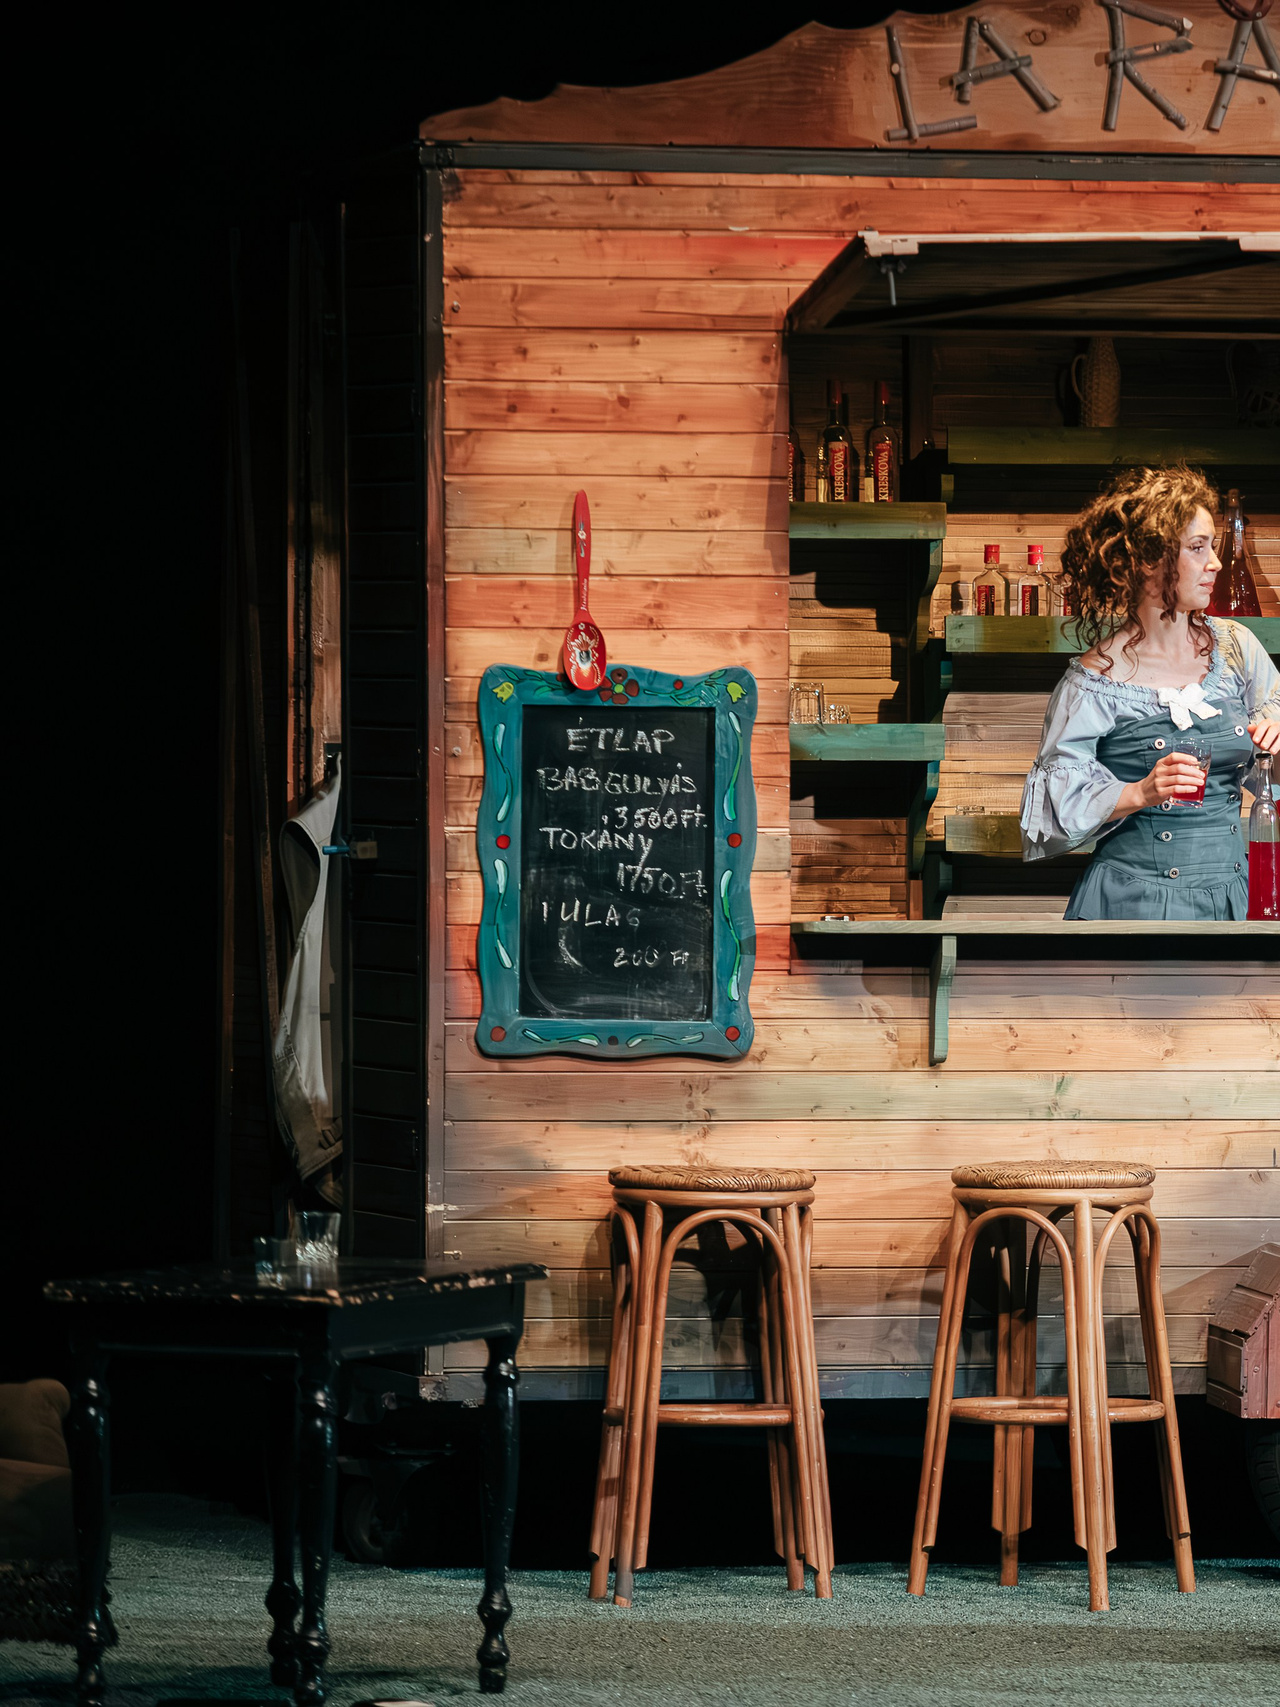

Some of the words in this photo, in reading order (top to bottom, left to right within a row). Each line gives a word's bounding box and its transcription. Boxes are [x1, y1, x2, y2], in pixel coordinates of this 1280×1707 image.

[884, 16, 1061, 143] LA
[834, 451, 845, 501] KRESKOVA
[878, 451, 889, 501] KRESKOVA
[566, 716, 675, 754] ÉTLAP
